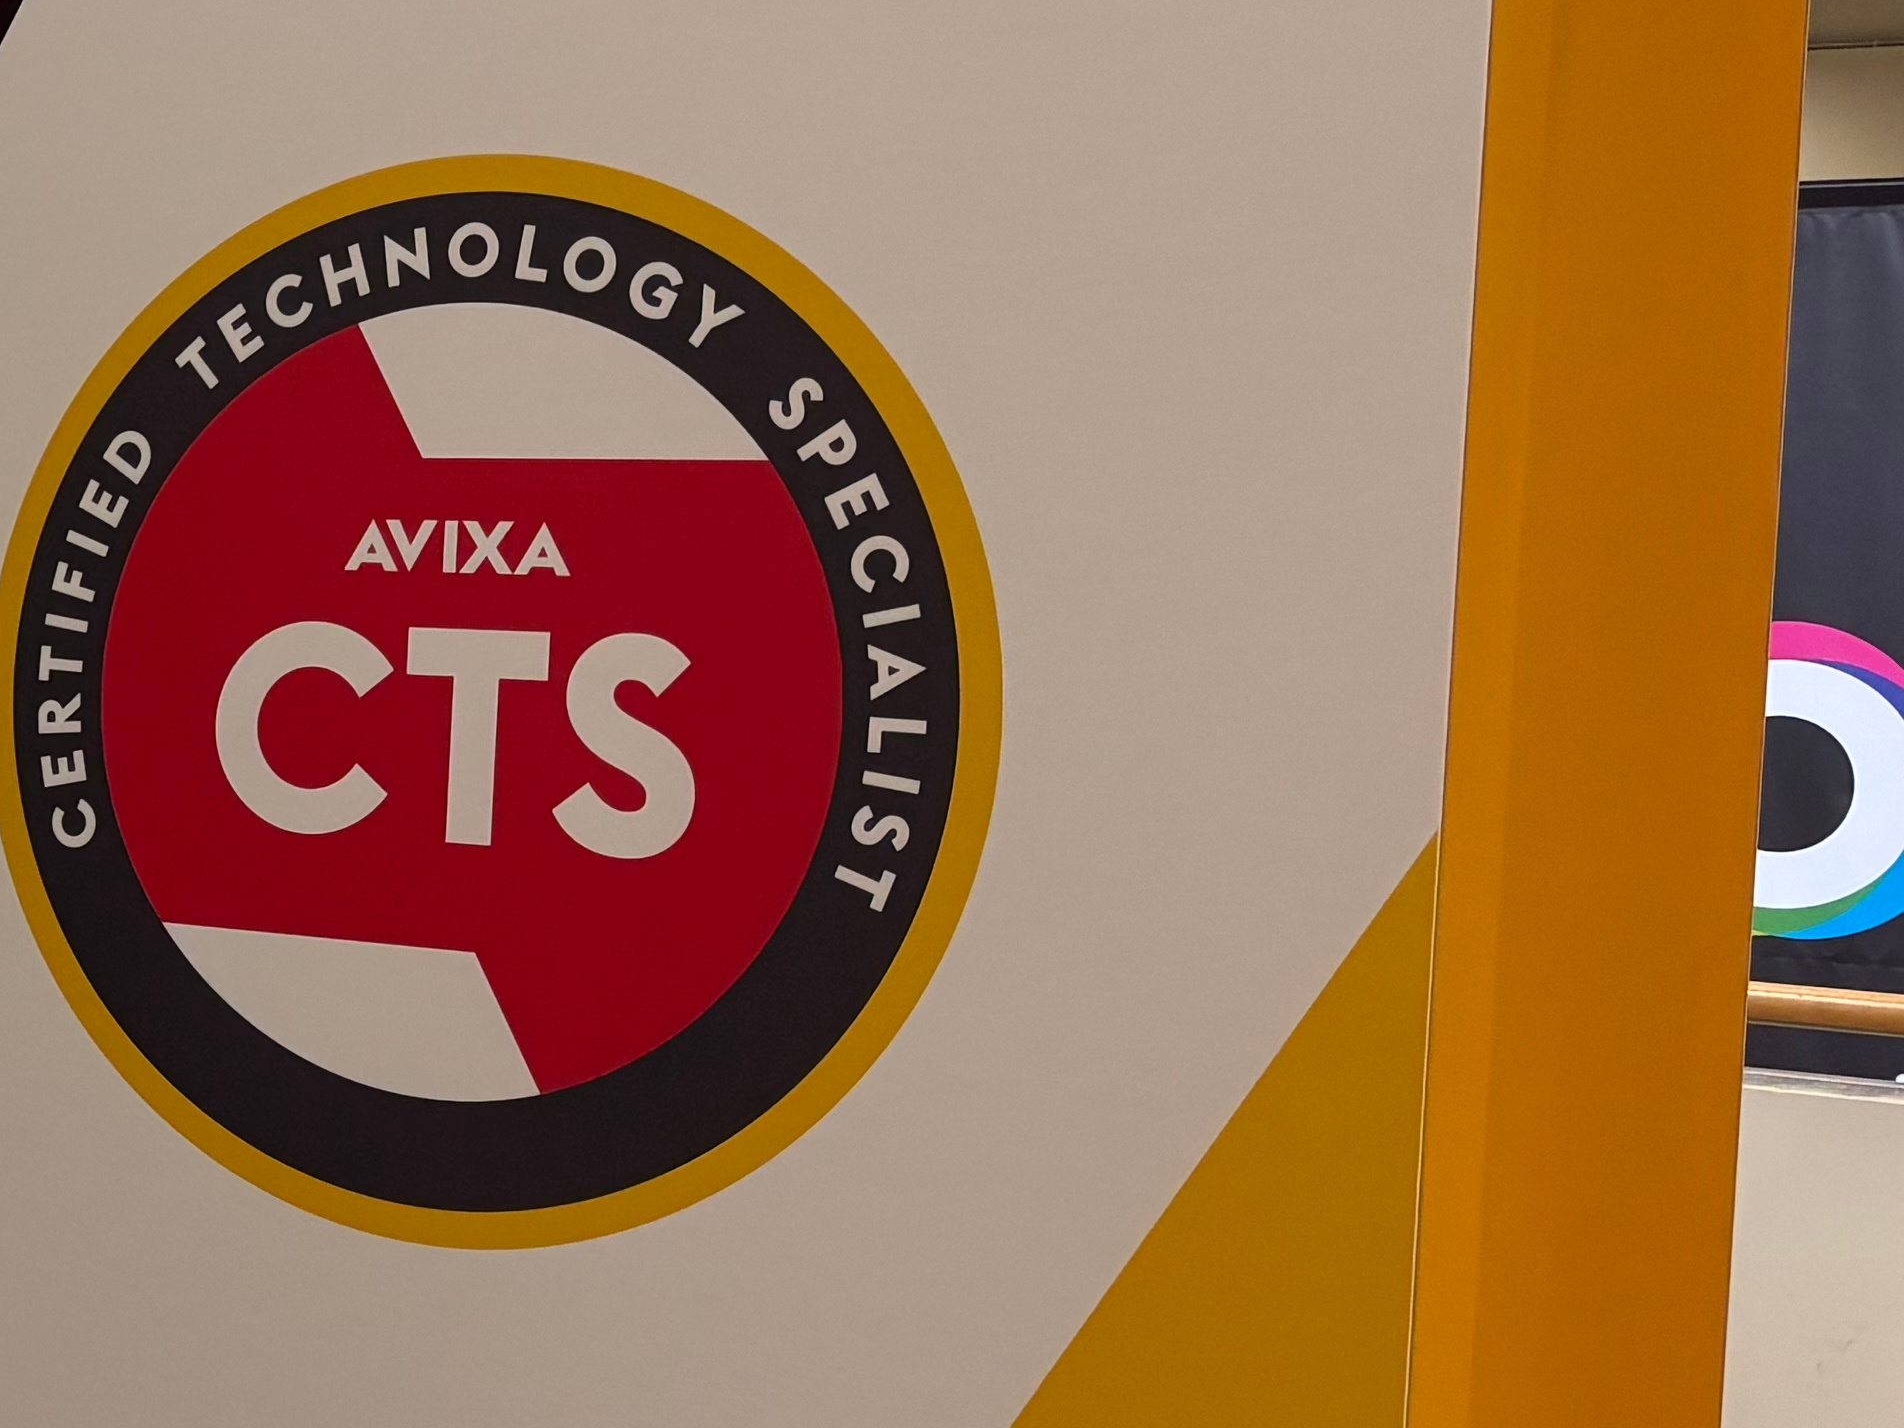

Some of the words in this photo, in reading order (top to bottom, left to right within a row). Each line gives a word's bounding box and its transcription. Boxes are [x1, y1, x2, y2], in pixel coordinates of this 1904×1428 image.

[36, 428, 153, 850] CERTIFIED
[175, 221, 745, 390] TECHNOLOGY
[768, 377, 929, 913] SPECIALIST
[344, 519, 571, 577] AVIXA
[215, 619, 696, 860] CTS
